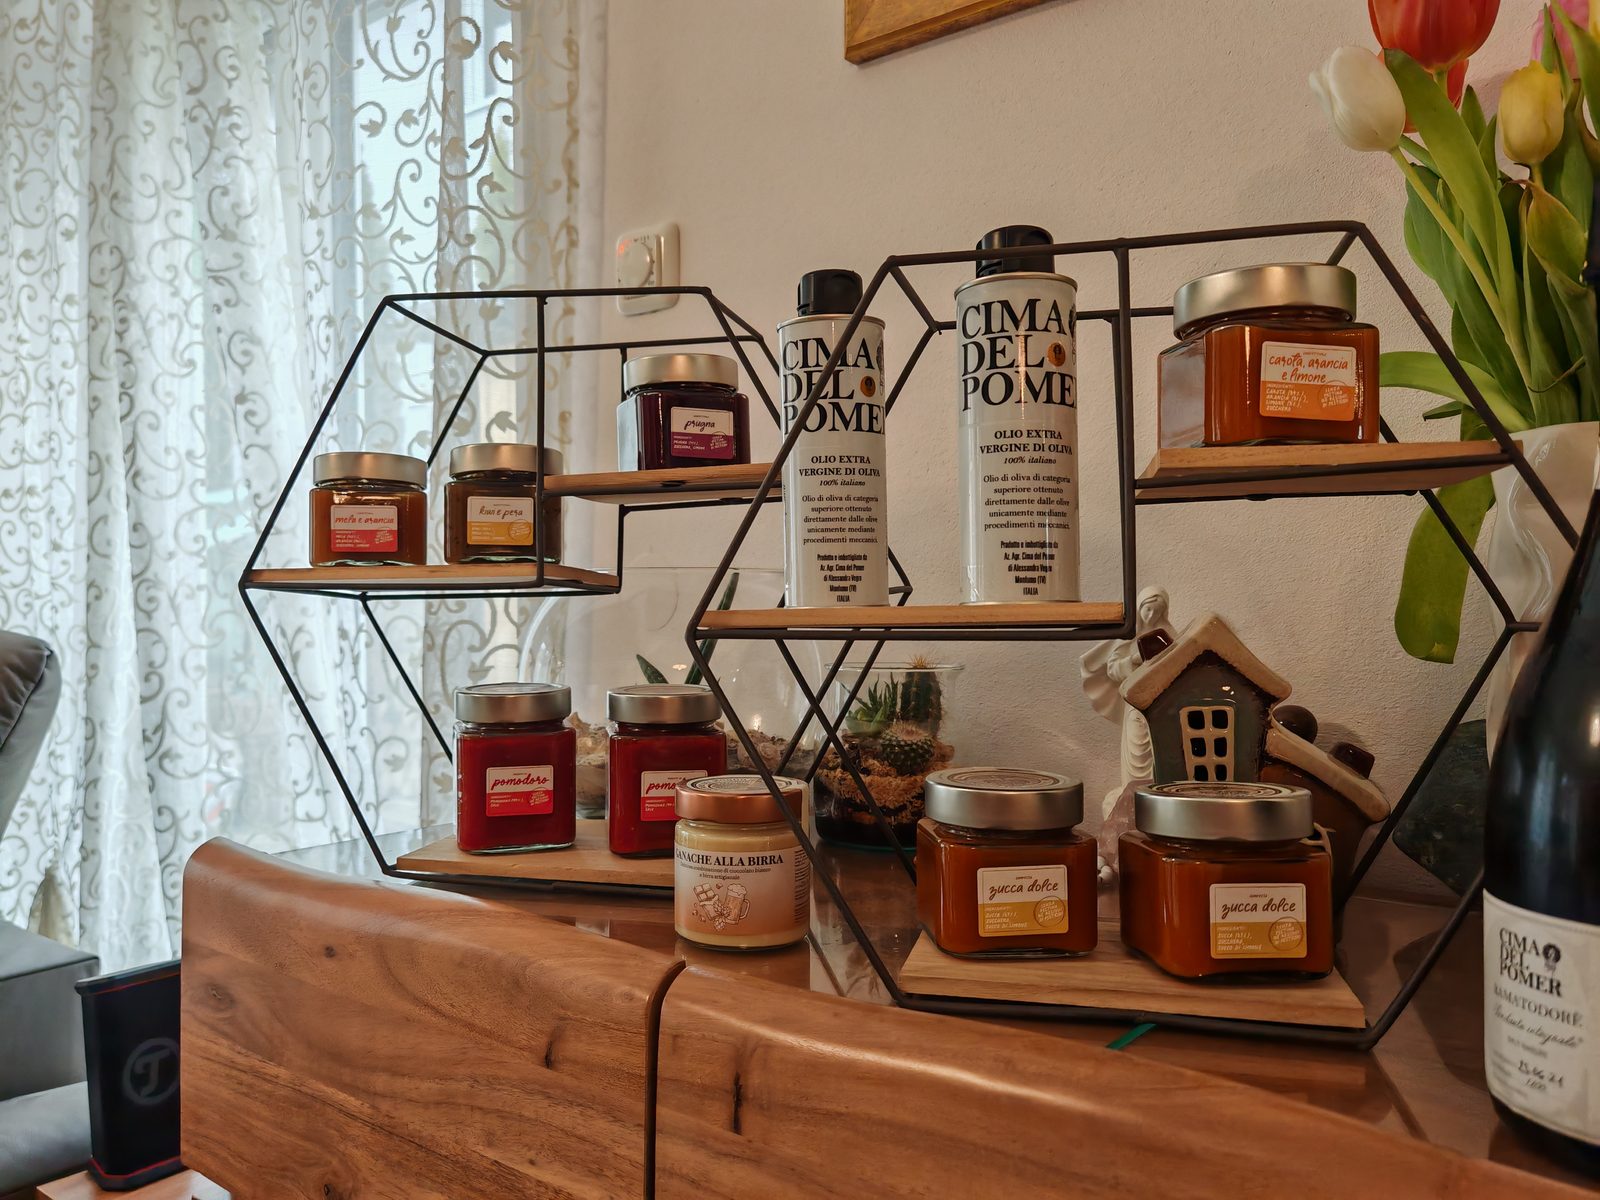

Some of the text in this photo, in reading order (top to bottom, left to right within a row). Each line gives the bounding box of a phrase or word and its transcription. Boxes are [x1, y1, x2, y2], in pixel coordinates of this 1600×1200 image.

[962, 299, 1067, 339] CIMA
[783, 338, 874, 370] CIMA
[962, 335, 1044, 377] DEL
[1308, 359, 1348, 369] arancia
[1282, 368, 1326, 383] e limone
[783, 370, 854, 403] DEL
[962, 371, 1076, 411] POME
[784, 402, 885, 435] POME
[684, 420, 715, 432] prugna
[994, 430, 1062, 439] OLIO EXTRA
[980, 444, 1072, 454] VERGINE DI OLIVA
[812, 456, 870, 464] OLIO EXTRA
[1004, 456, 1056, 464] 100% italiano
[799, 468, 880, 477] VERGINE DI OLIVA
[994, 486, 1031, 495] superiore
[1037, 497, 1054, 505] dalle
[502, 510, 523, 519] pera
[1037, 509, 1067, 517] mediante
[985, 521, 1035, 531] procedimenti
[803, 536, 846, 545] procedimenti
[491, 773, 549, 791] pomodoro
[646, 783, 676, 795] pomo
[676, 848, 784, 866] GANACHE ALLA BIRRA
[989, 879, 1058, 900] zucca dolce
[1222, 898, 1296, 919] zucca dolce
[1500, 928, 1540, 956] CIMA
[1500, 943, 1529, 970] DEL
[1500, 960, 1562, 998] POMER
